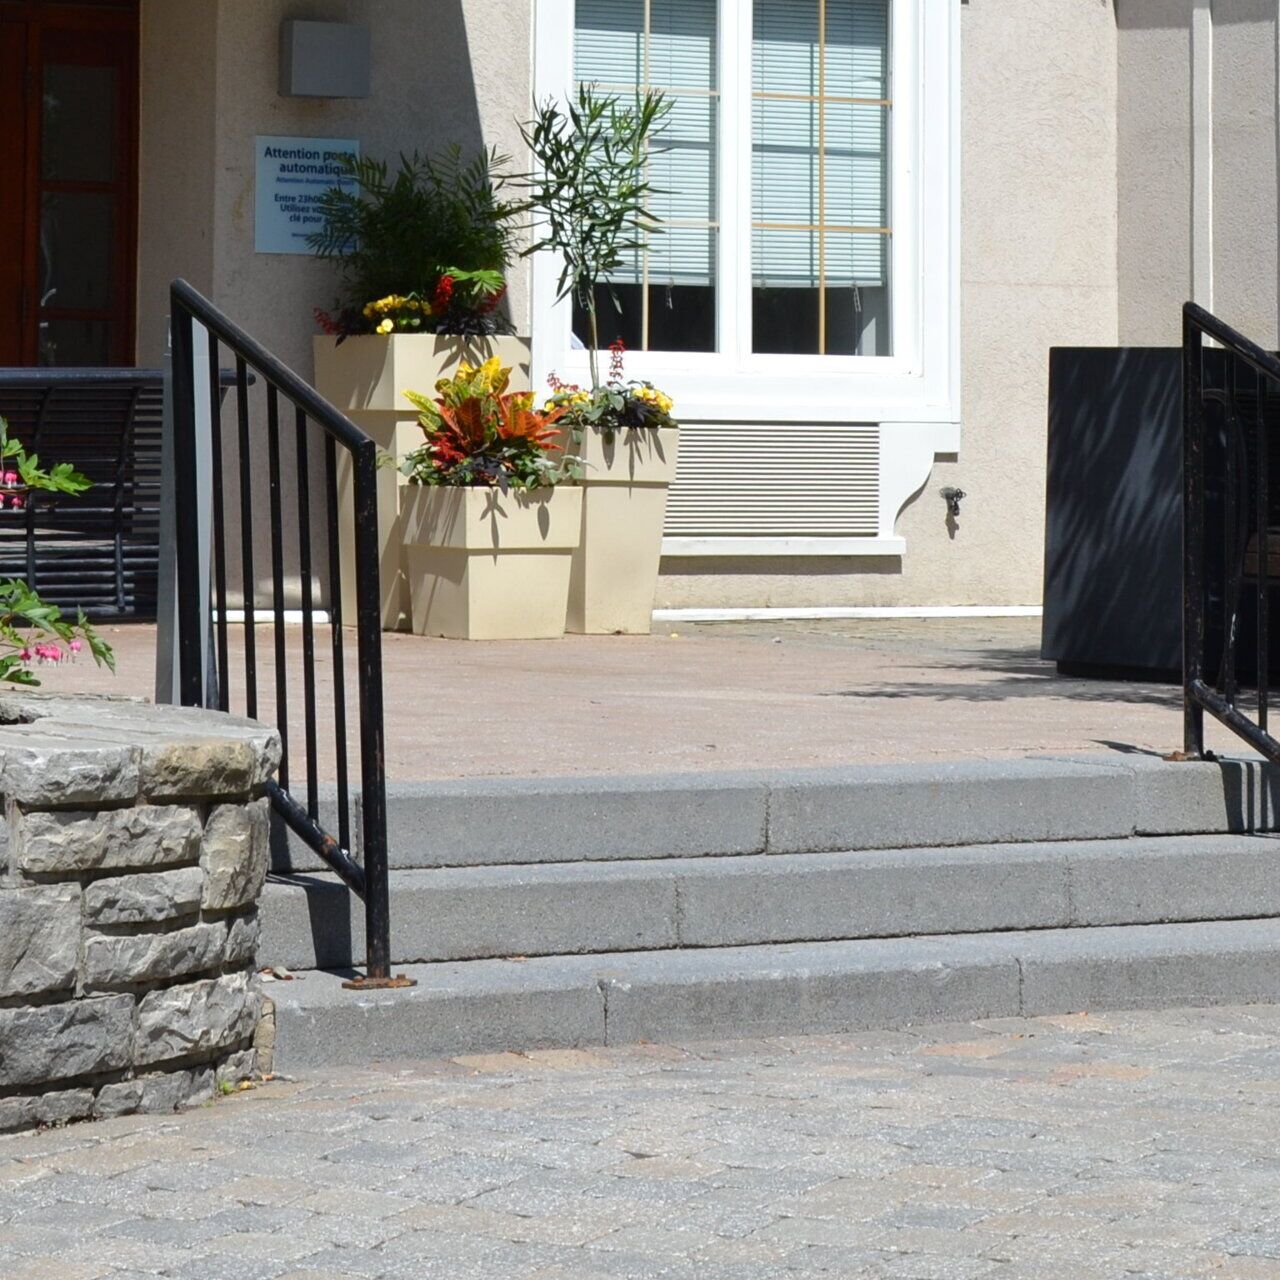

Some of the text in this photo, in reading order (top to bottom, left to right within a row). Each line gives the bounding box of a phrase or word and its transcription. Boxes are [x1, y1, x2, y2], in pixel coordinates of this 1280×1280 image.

[265, 147, 319, 160] Attention
[274, 193, 296, 203] Entre
[280, 203, 310, 213] Utilisez
[303, 215, 322, 224] pour
